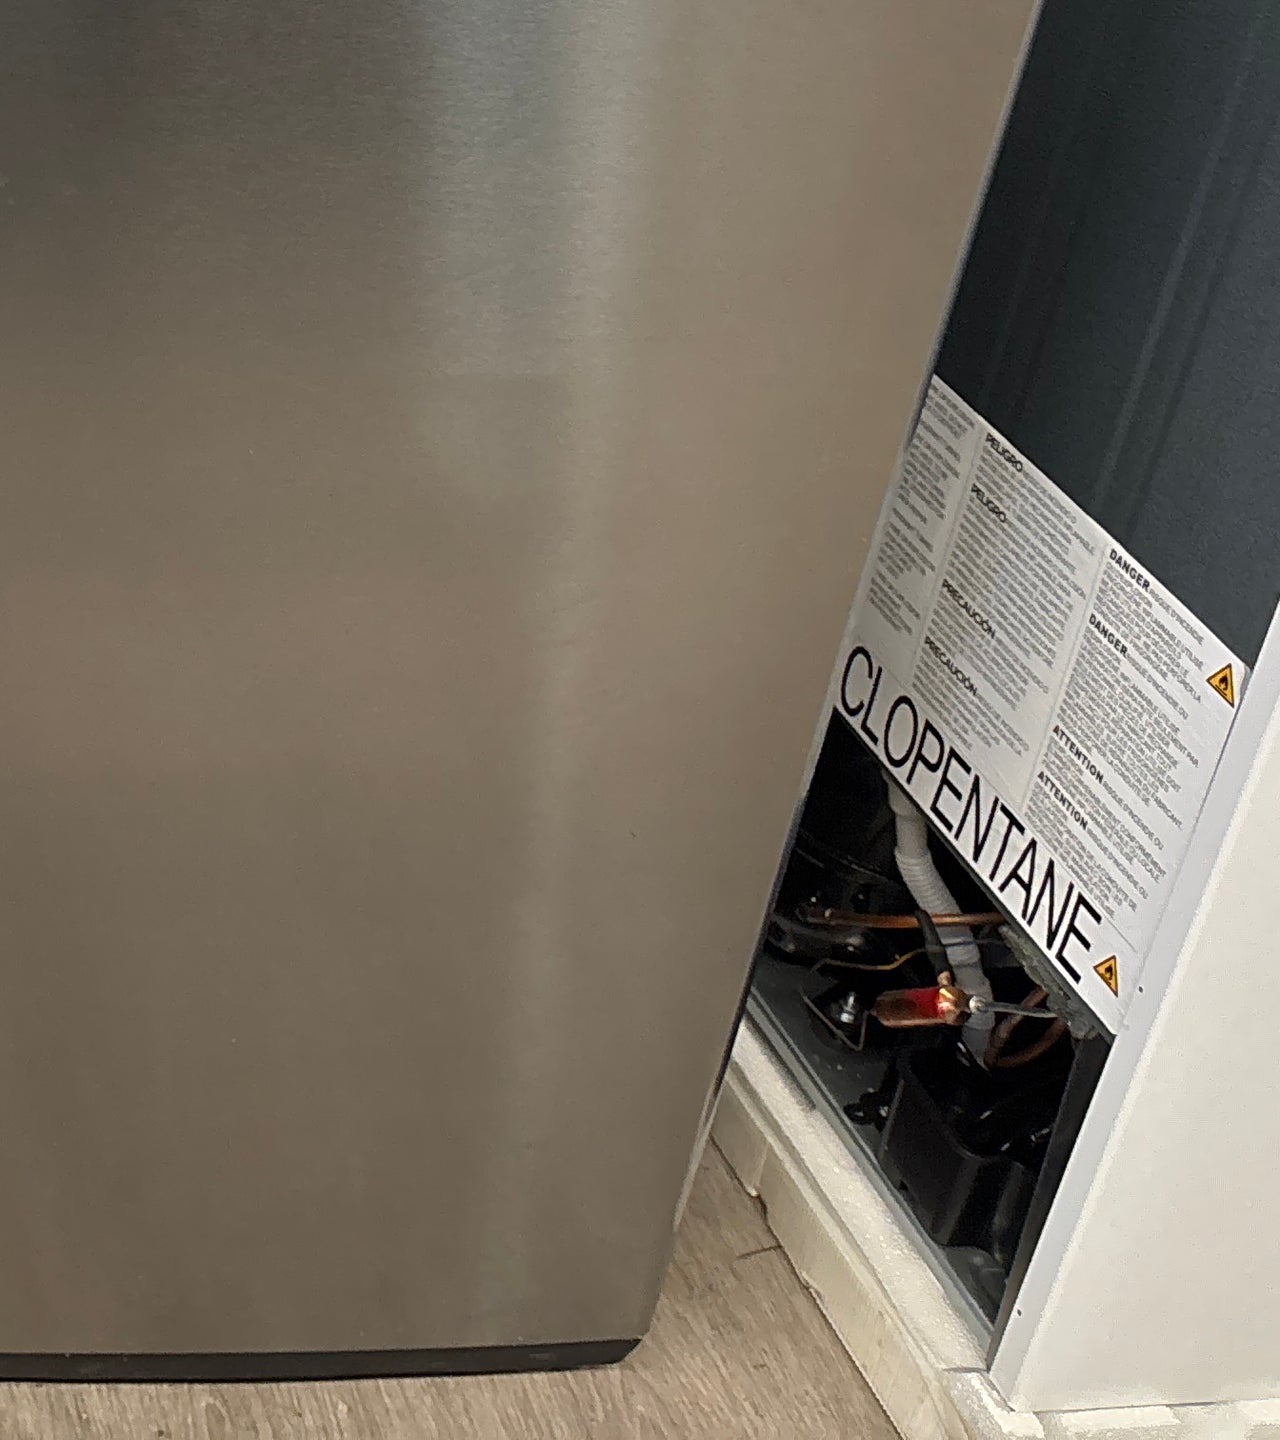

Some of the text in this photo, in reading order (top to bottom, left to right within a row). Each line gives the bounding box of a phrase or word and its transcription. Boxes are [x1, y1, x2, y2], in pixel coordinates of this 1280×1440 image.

[984, 430, 1024, 474] PELIGRO
[969, 481, 1007, 525] PELIGRO
[1108, 547, 1150, 593] DANGER
[1087, 612, 1128, 658] DANGER
[1051, 722, 1104, 784] ATTENTION
[840, 645, 1101, 984] CLOPENTANE
[1036, 768, 1088, 831] ATTENTION
